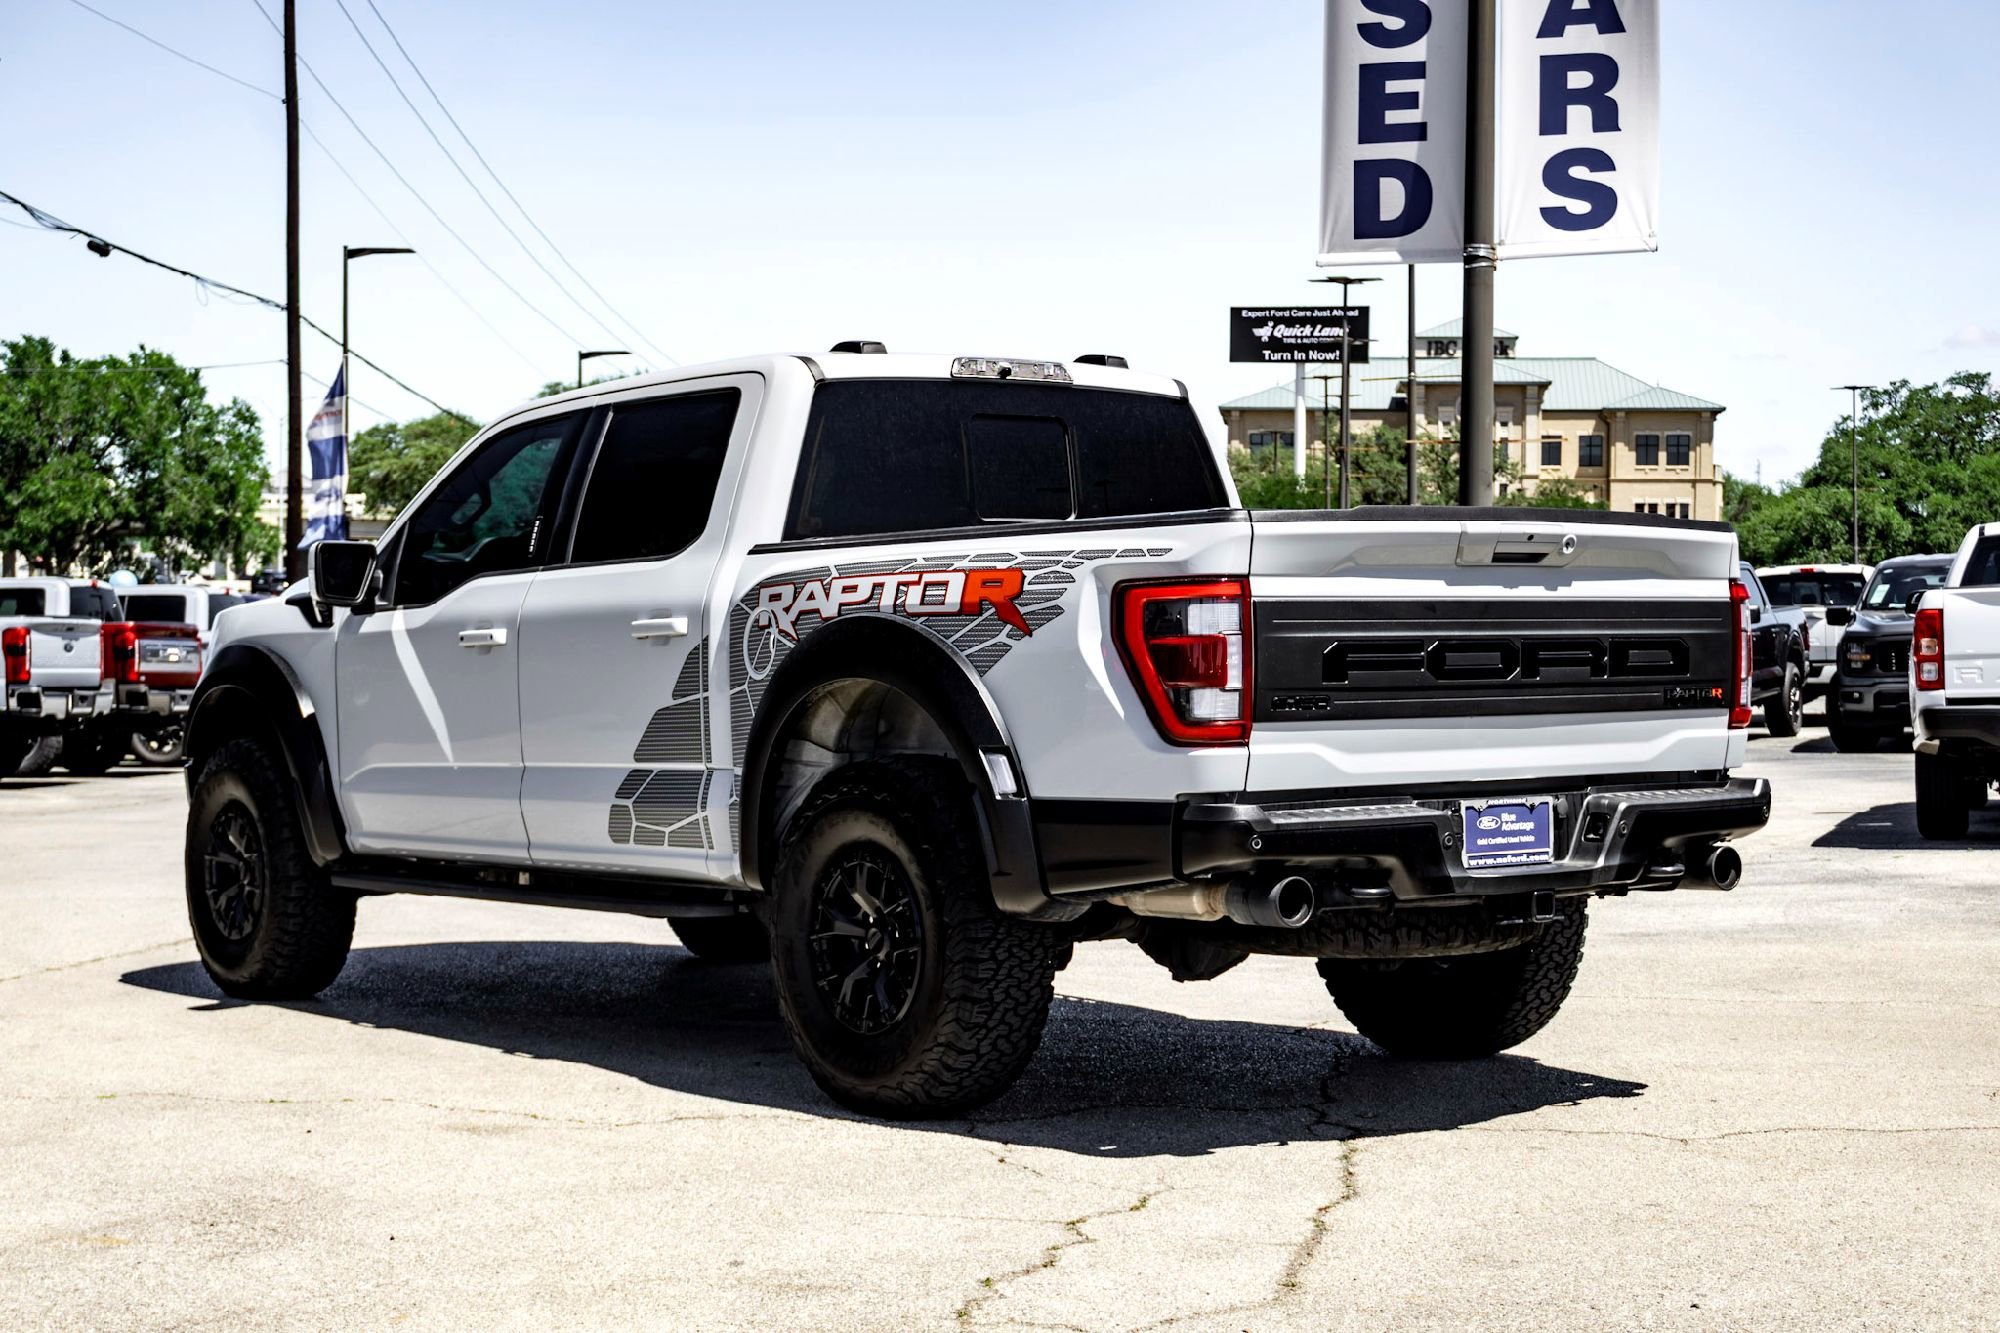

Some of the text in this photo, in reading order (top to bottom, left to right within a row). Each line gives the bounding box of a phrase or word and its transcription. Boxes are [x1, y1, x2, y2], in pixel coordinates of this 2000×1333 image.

[1241, 309, 1269, 318] Expert
[1270, 309, 1290, 317] Ford
[1291, 309, 1312, 317] Care
[1312, 309, 1331, 317] Just
[1273, 324, 1313, 338] Quick
[1426, 340, 1458, 356] IBC
[1262, 350, 1340, 360] Turn In Now!
[758, 567, 1032, 641] RAPTOR
[1322, 638, 1690, 685] FORD
[1501, 813, 1516, 822] Blue
[1502, 821, 1535, 831] Advantage
